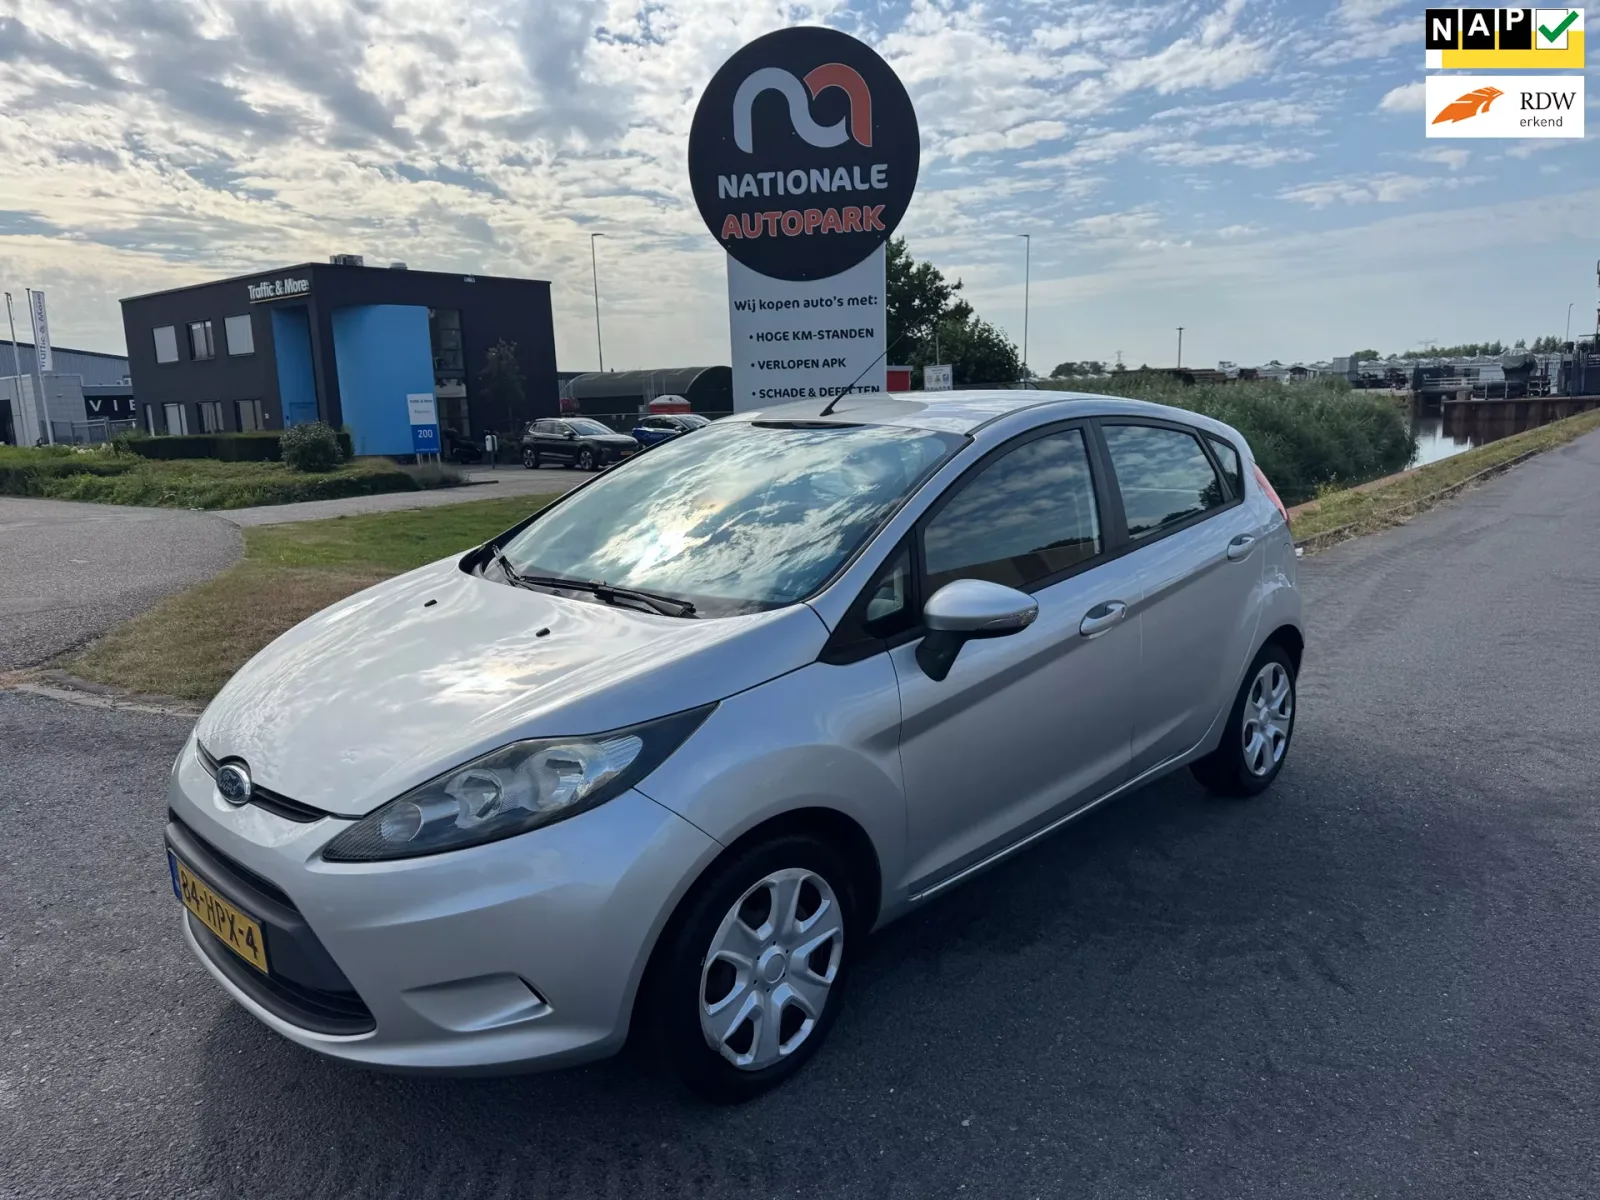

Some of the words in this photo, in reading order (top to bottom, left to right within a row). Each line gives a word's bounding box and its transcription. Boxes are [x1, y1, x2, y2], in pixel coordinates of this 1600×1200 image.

[717, 163, 889, 199] NATIONALE
[721, 204, 886, 240] AUTOPARK
[247, 281, 275, 300] Traffic
[275, 280, 283, 296] &
[284, 277, 310, 294] More
[734, 299, 756, 313] Wij
[759, 299, 800, 312] kopen
[803, 296, 844, 308] auto's
[847, 294, 878, 307] met:
[756, 331, 790, 342] HOGE
[792, 328, 875, 341] KM-STANDEN
[758, 359, 820, 370] VERLOPEN
[822, 357, 846, 368] APK
[759, 388, 806, 399] SCHADE
[808, 387, 817, 398] &
[417, 429, 433, 439] 200
[181, 869, 259, 960] 84-HPX-4
